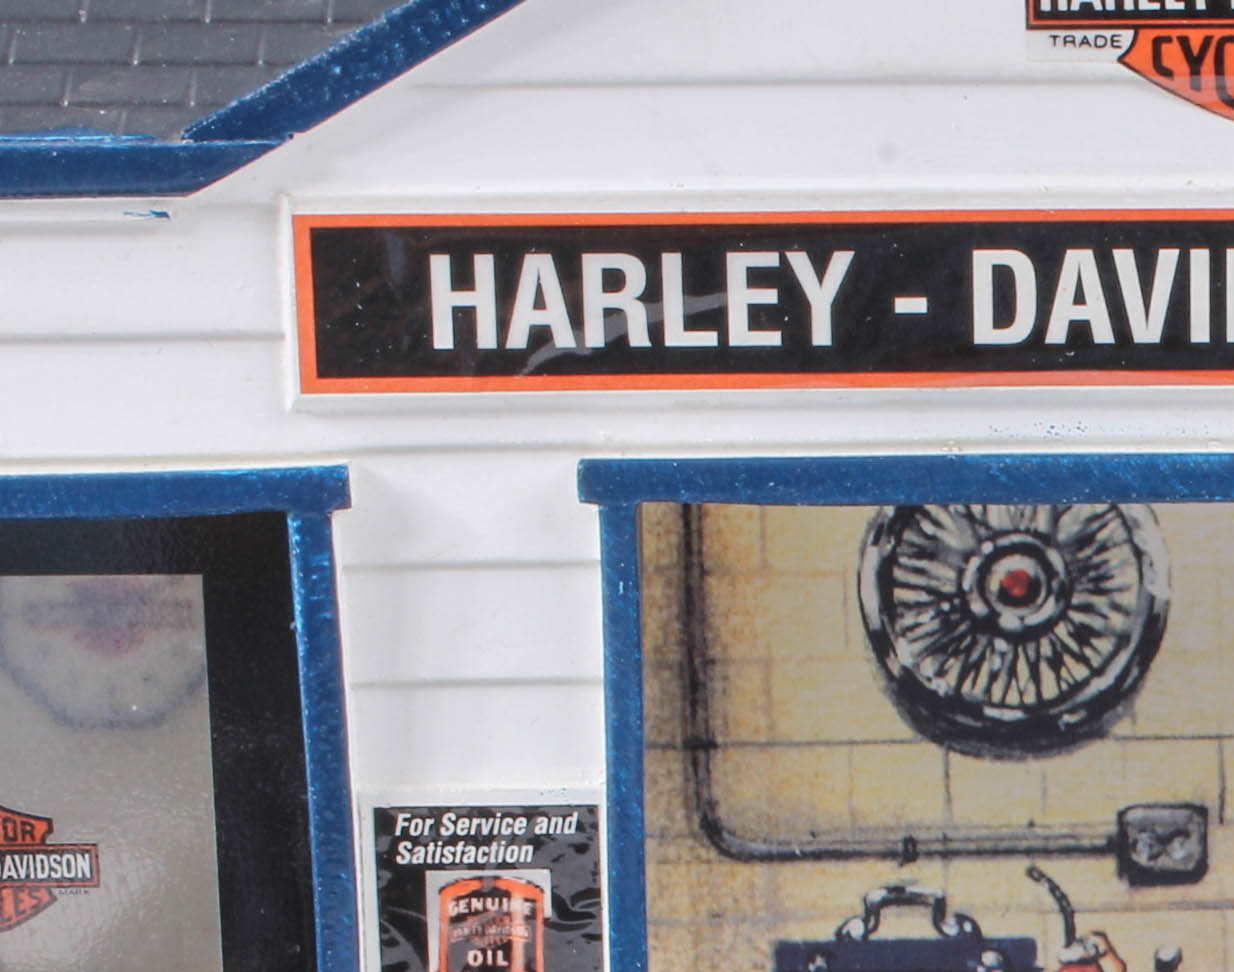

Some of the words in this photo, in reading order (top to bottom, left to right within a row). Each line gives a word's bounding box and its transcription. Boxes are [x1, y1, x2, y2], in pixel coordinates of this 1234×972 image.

[1048, 34, 1122, 48] TRADE
[427, 250, 856, 351] HARLEY
[395, 813, 434, 837] For
[439, 811, 527, 836] Service
[534, 811, 578, 835] and
[396, 840, 534, 865] Satisfaction
[0, 853, 92, 880] AVIDSON
[448, 896, 534, 917] GENUIE
[467, 950, 509, 967] OIL
